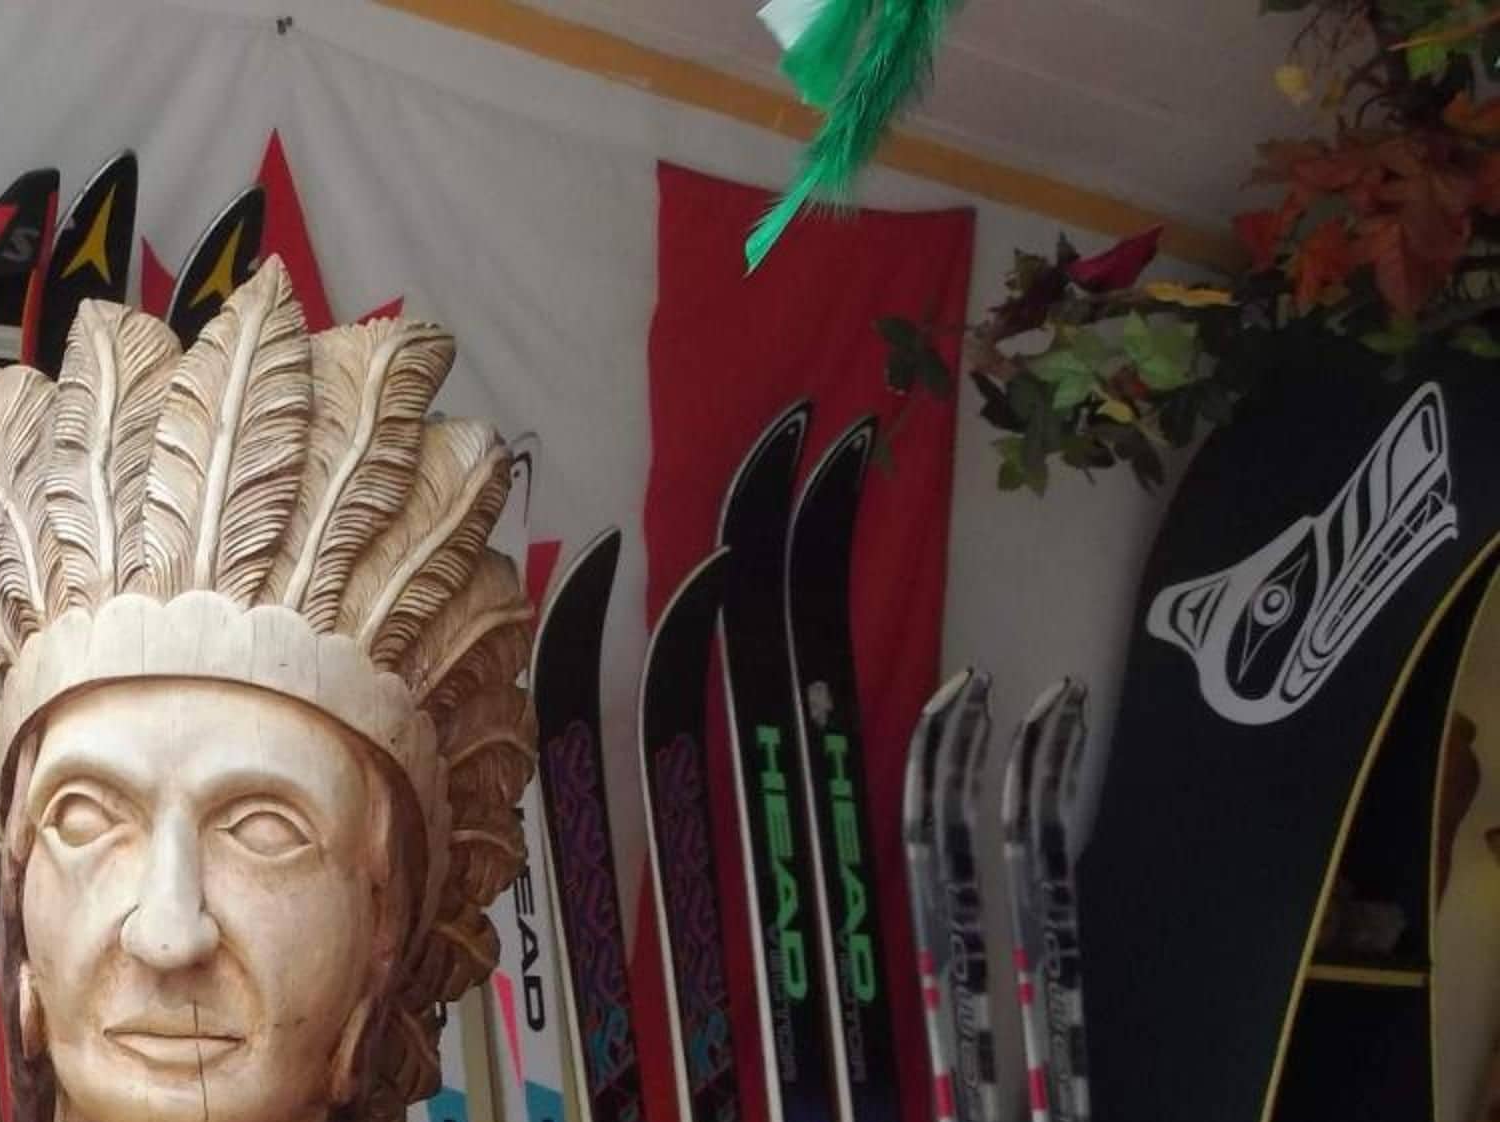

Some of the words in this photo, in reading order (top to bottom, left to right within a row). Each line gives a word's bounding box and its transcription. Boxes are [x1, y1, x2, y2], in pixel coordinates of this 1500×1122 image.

[512, 808, 545, 1033] EAD
[756, 725, 808, 1002] HEAD
[824, 734, 877, 1002] HEAD
